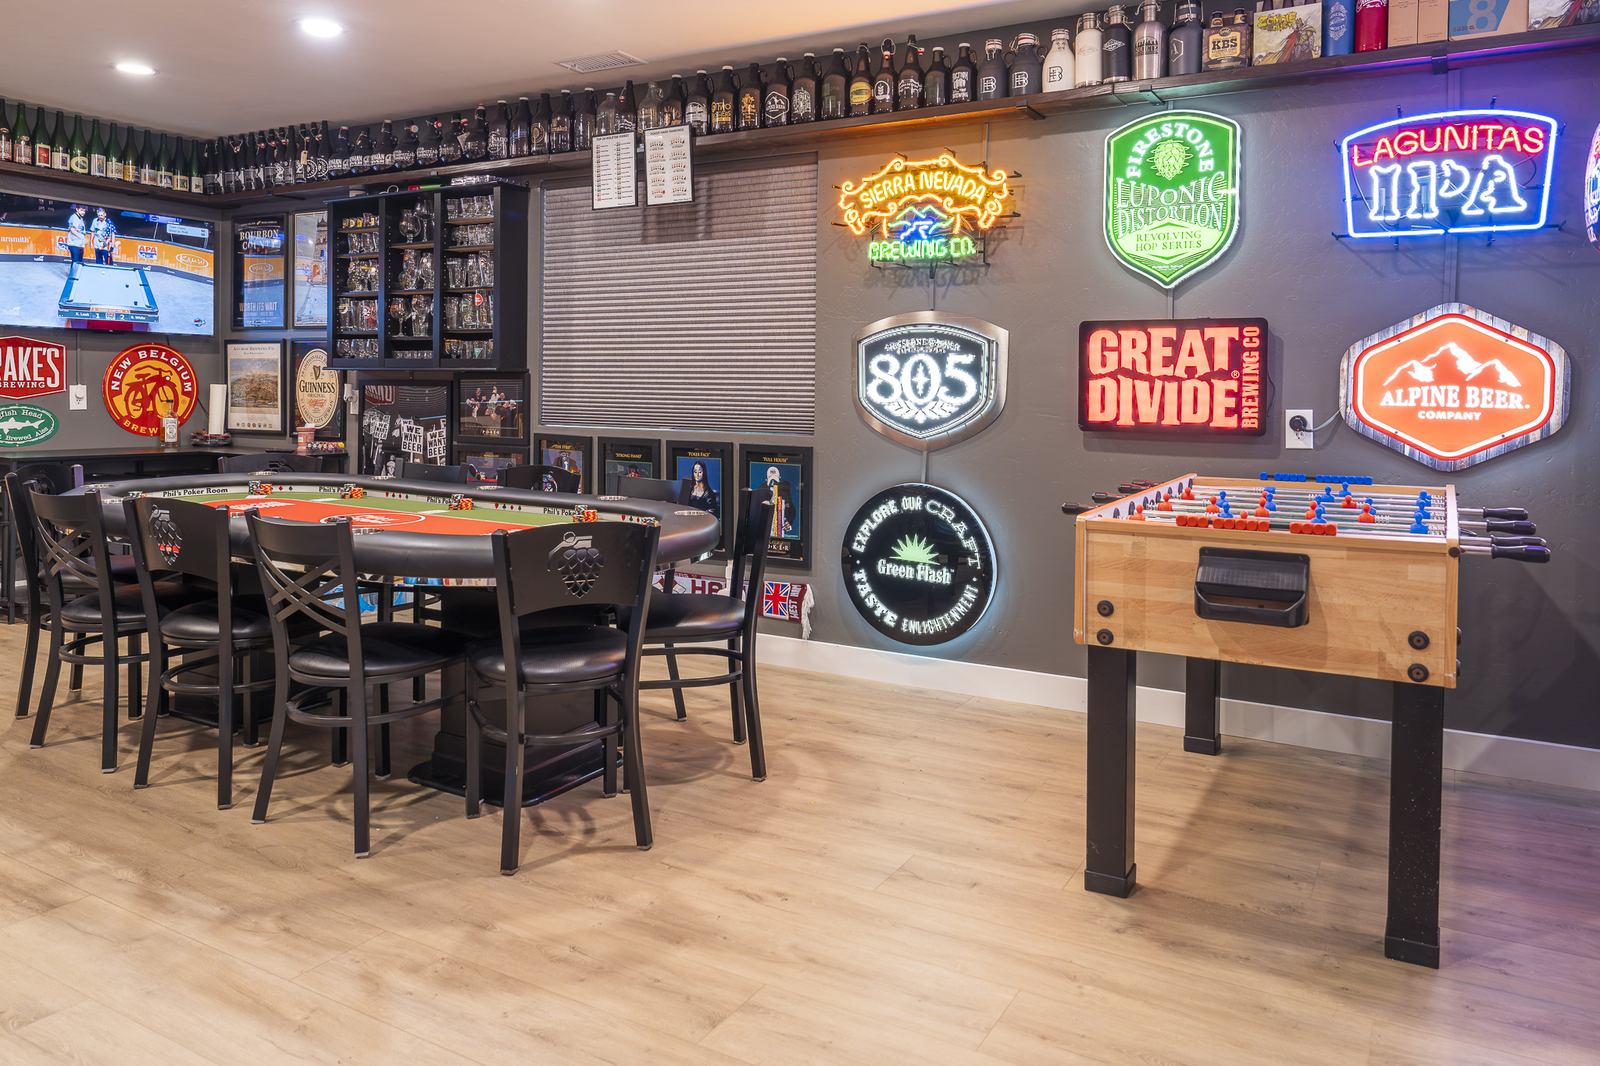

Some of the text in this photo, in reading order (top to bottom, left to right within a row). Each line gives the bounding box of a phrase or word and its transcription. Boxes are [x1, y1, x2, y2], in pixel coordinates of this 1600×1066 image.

[1212, 39, 1237, 50] KBS
[1126, 122, 1214, 179] FIRESTONE
[1352, 124, 1545, 168] LAGUNITAS
[859, 171, 986, 208] SIERRA NEVADA
[1116, 171, 1226, 208] LUPONIC
[1368, 154, 1528, 220] IPA
[1116, 202, 1224, 239] DISTORTION
[240, 229, 279, 240] BOURBON
[1136, 230, 1202, 242] REVOLVING
[1136, 240, 1202, 252] HOP SERIES
[868, 238, 948, 260] BREWING
[1088, 327, 1240, 378] GREAT
[0, 346, 60, 388] AKE'S
[111, 350, 192, 392] NEW BELGIUM
[866, 353, 977, 405] 805
[1241, 326, 1260, 429] BREWING CO
[300, 380, 335, 393] GUINNESS
[1380, 385, 1460, 408] ALPINE
[1088, 375, 1239, 428] DIVIDE
[22, 410, 42, 419] Head
[123, 420, 158, 434] BREW
[1418, 410, 1482, 421] COMPANY
[404, 434, 422, 442] WANT
[406, 426, 420, 434] WE
[430, 431, 444, 439] WE
[403, 442, 421, 452] BEER
[852, 496, 981, 570] EXPLORE OUR CRAFT
[877, 559, 950, 584] Green Flash
[853, 568, 979, 635] TASTE ENLIGHTENMENT
